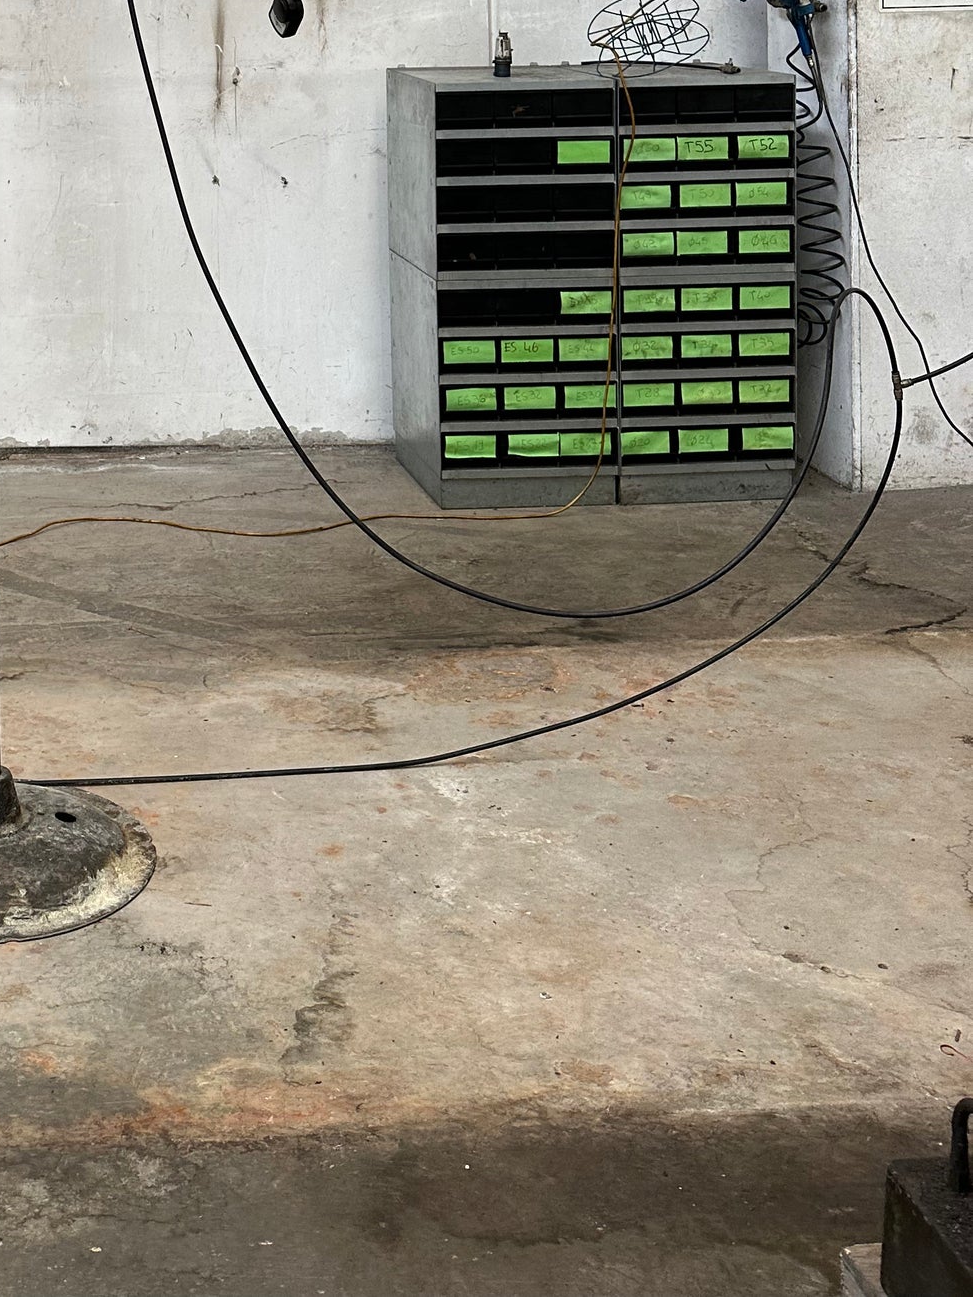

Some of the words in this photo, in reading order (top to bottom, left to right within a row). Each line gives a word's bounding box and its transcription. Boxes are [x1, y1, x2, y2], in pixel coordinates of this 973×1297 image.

[684, 138, 715, 154] T55
[748, 136, 778, 152] T52
[524, 341, 539, 353] 46
